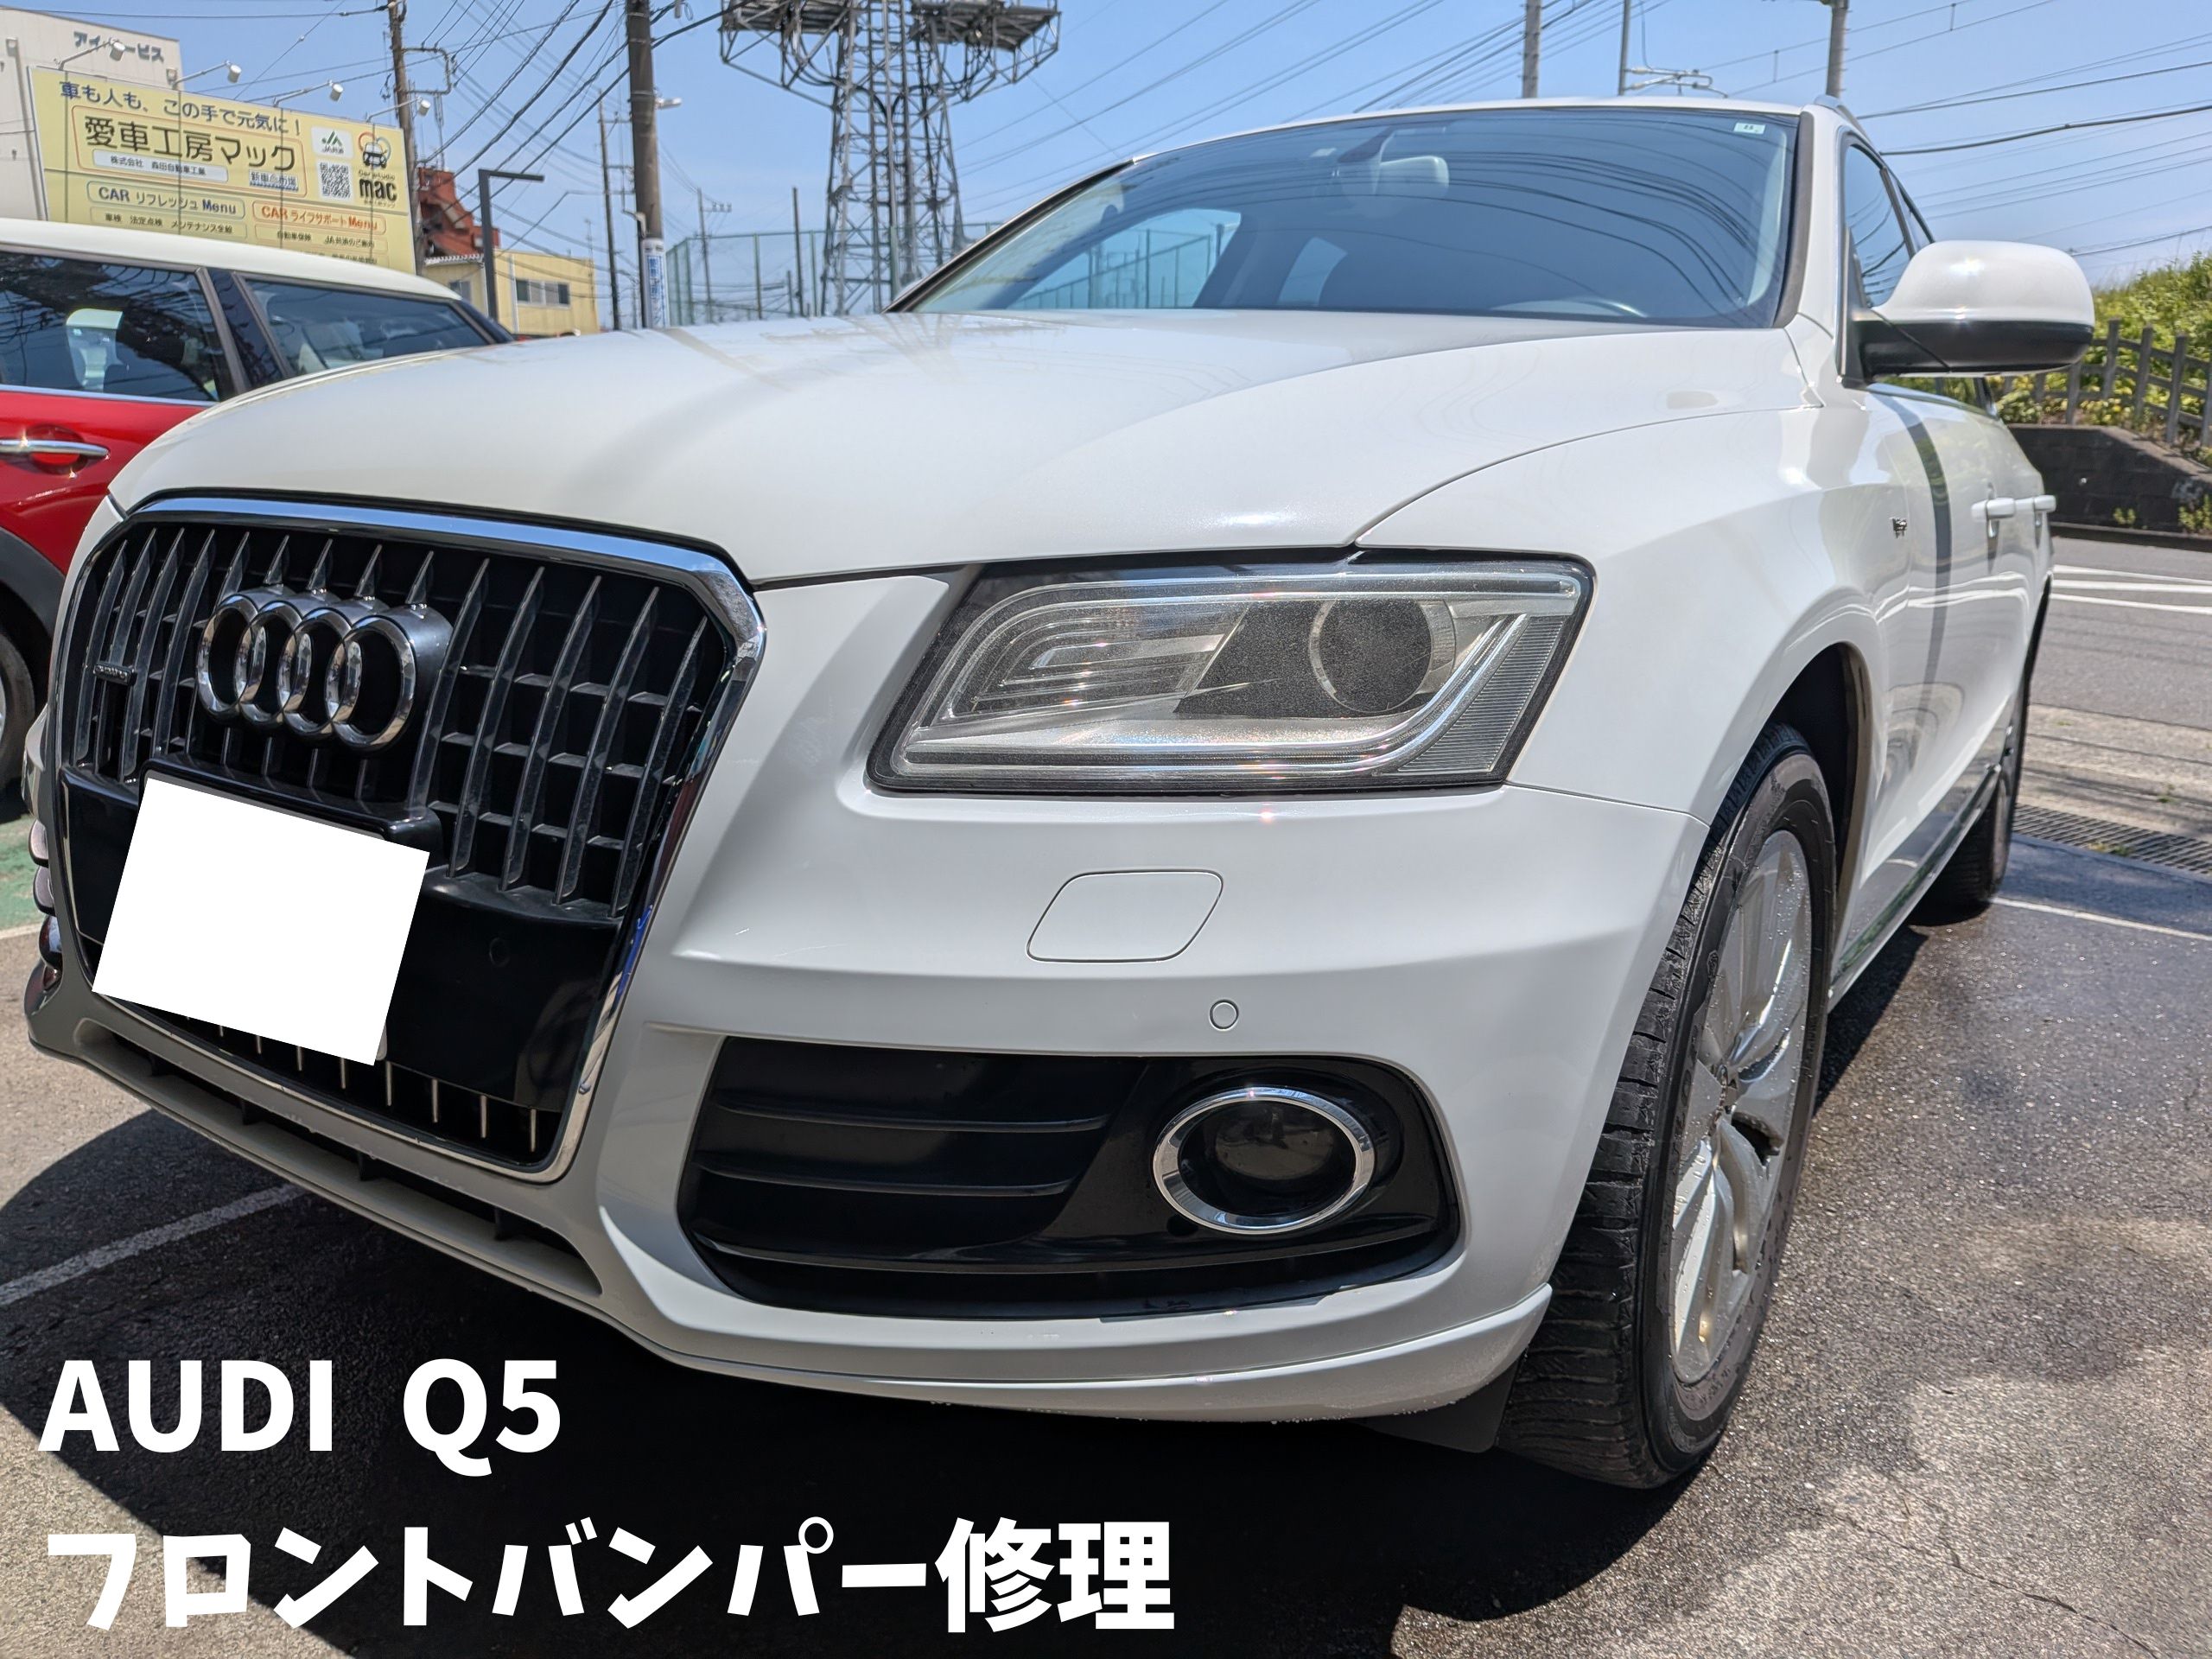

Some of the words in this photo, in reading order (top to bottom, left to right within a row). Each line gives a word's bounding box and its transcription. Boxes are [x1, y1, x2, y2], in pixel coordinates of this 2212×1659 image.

[73, 30, 164, 62] アイービス
[85, 116, 296, 171] 愛車工房マック
[110, 155, 144, 168] 株式会社
[99, 186, 130, 202] CAR
[136, 192, 199, 211] リフレッシュ
[201, 199, 237, 215] Menu
[359, 178, 397, 201] mac
[105, 213, 122, 223] 車検
[130, 214, 163, 227] 法定点検
[261, 205, 289, 220] CAR
[290, 211, 347, 227] ライフサポート
[348, 216, 378, 231] Menu
